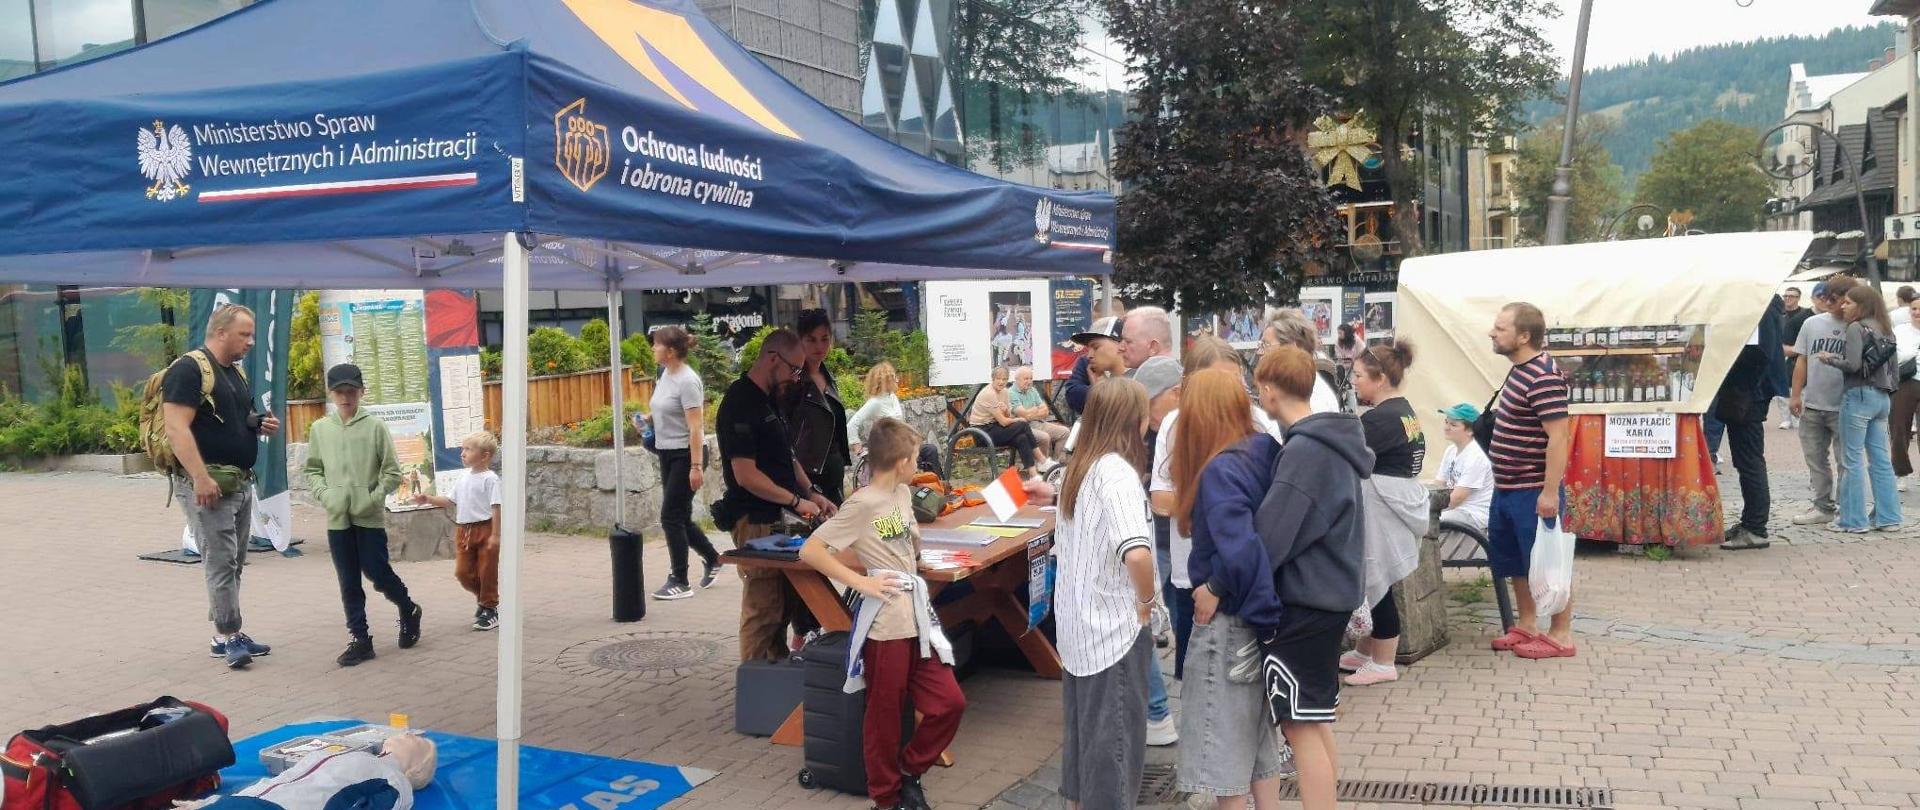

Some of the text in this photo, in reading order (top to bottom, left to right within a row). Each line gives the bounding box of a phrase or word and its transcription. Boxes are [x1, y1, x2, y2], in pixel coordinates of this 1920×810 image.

[193, 113, 376, 146] Ministerstwo Spraw
[621, 125, 763, 181] Ochrona ludności
[198, 131, 477, 178] Wewnętrznych i Administracji
[620, 158, 754, 208] i obrona cywilna
